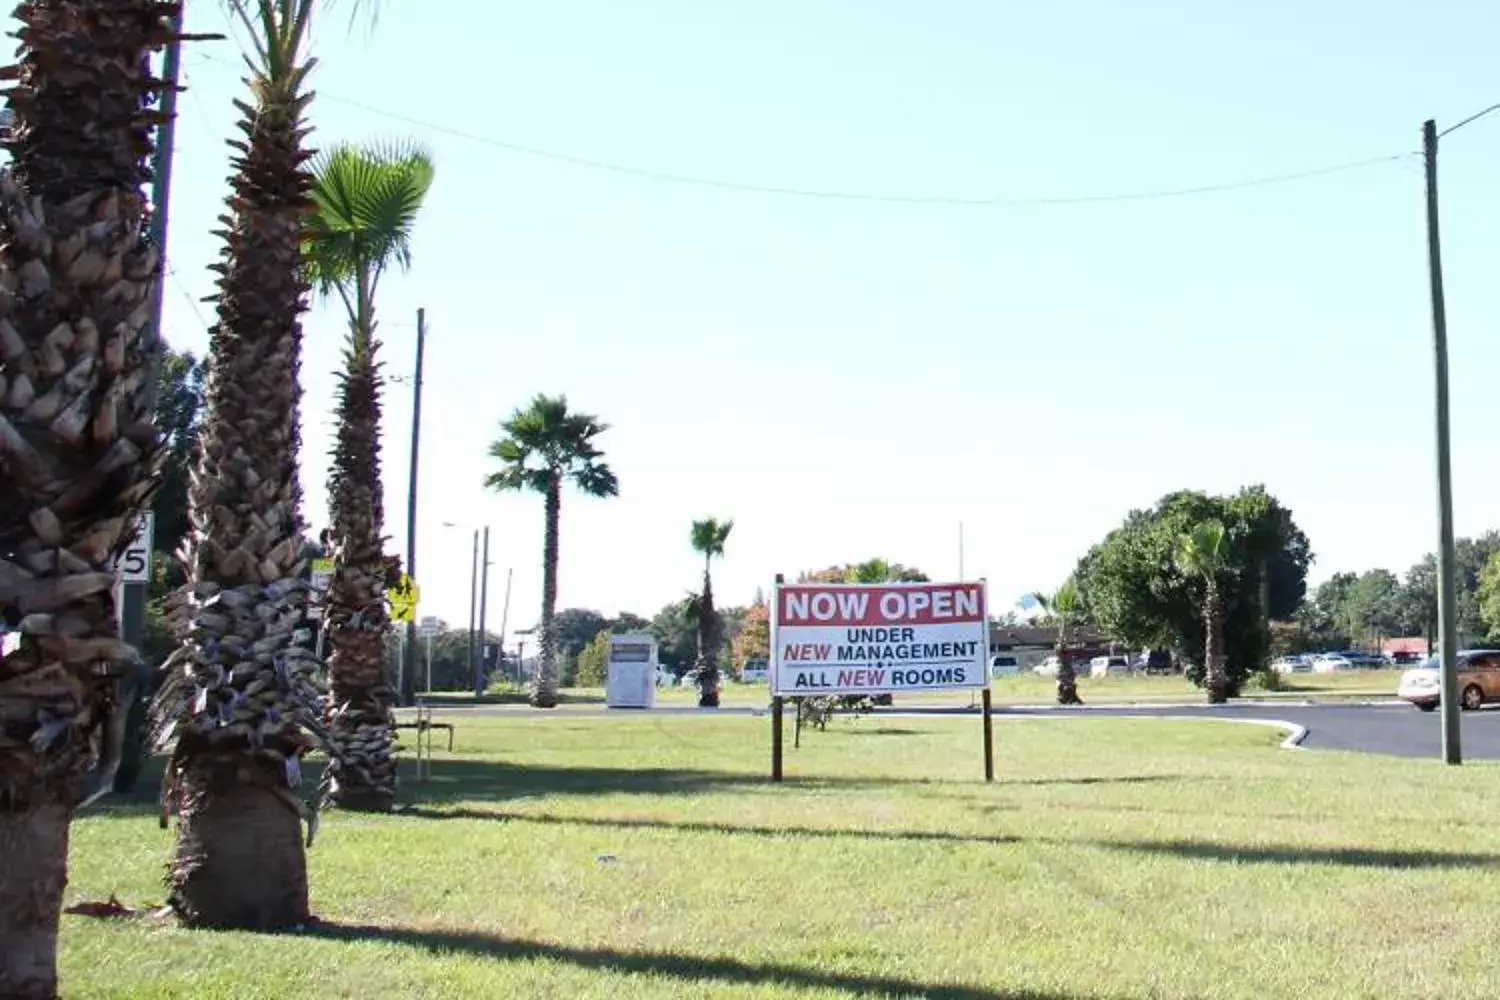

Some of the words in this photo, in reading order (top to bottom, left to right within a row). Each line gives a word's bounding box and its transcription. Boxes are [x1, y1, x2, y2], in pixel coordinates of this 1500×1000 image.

[113, 549, 146, 574] 5
[785, 592, 869, 620] NOW
[879, 590, 978, 619] OPEN
[847, 628, 914, 643] UNDER
[784, 644, 831, 660] NEW
[837, 641, 978, 661] MANAGEMENT
[795, 672, 830, 688] ALL
[837, 669, 886, 686] NEW
[892, 668, 965, 685] ROOMS
